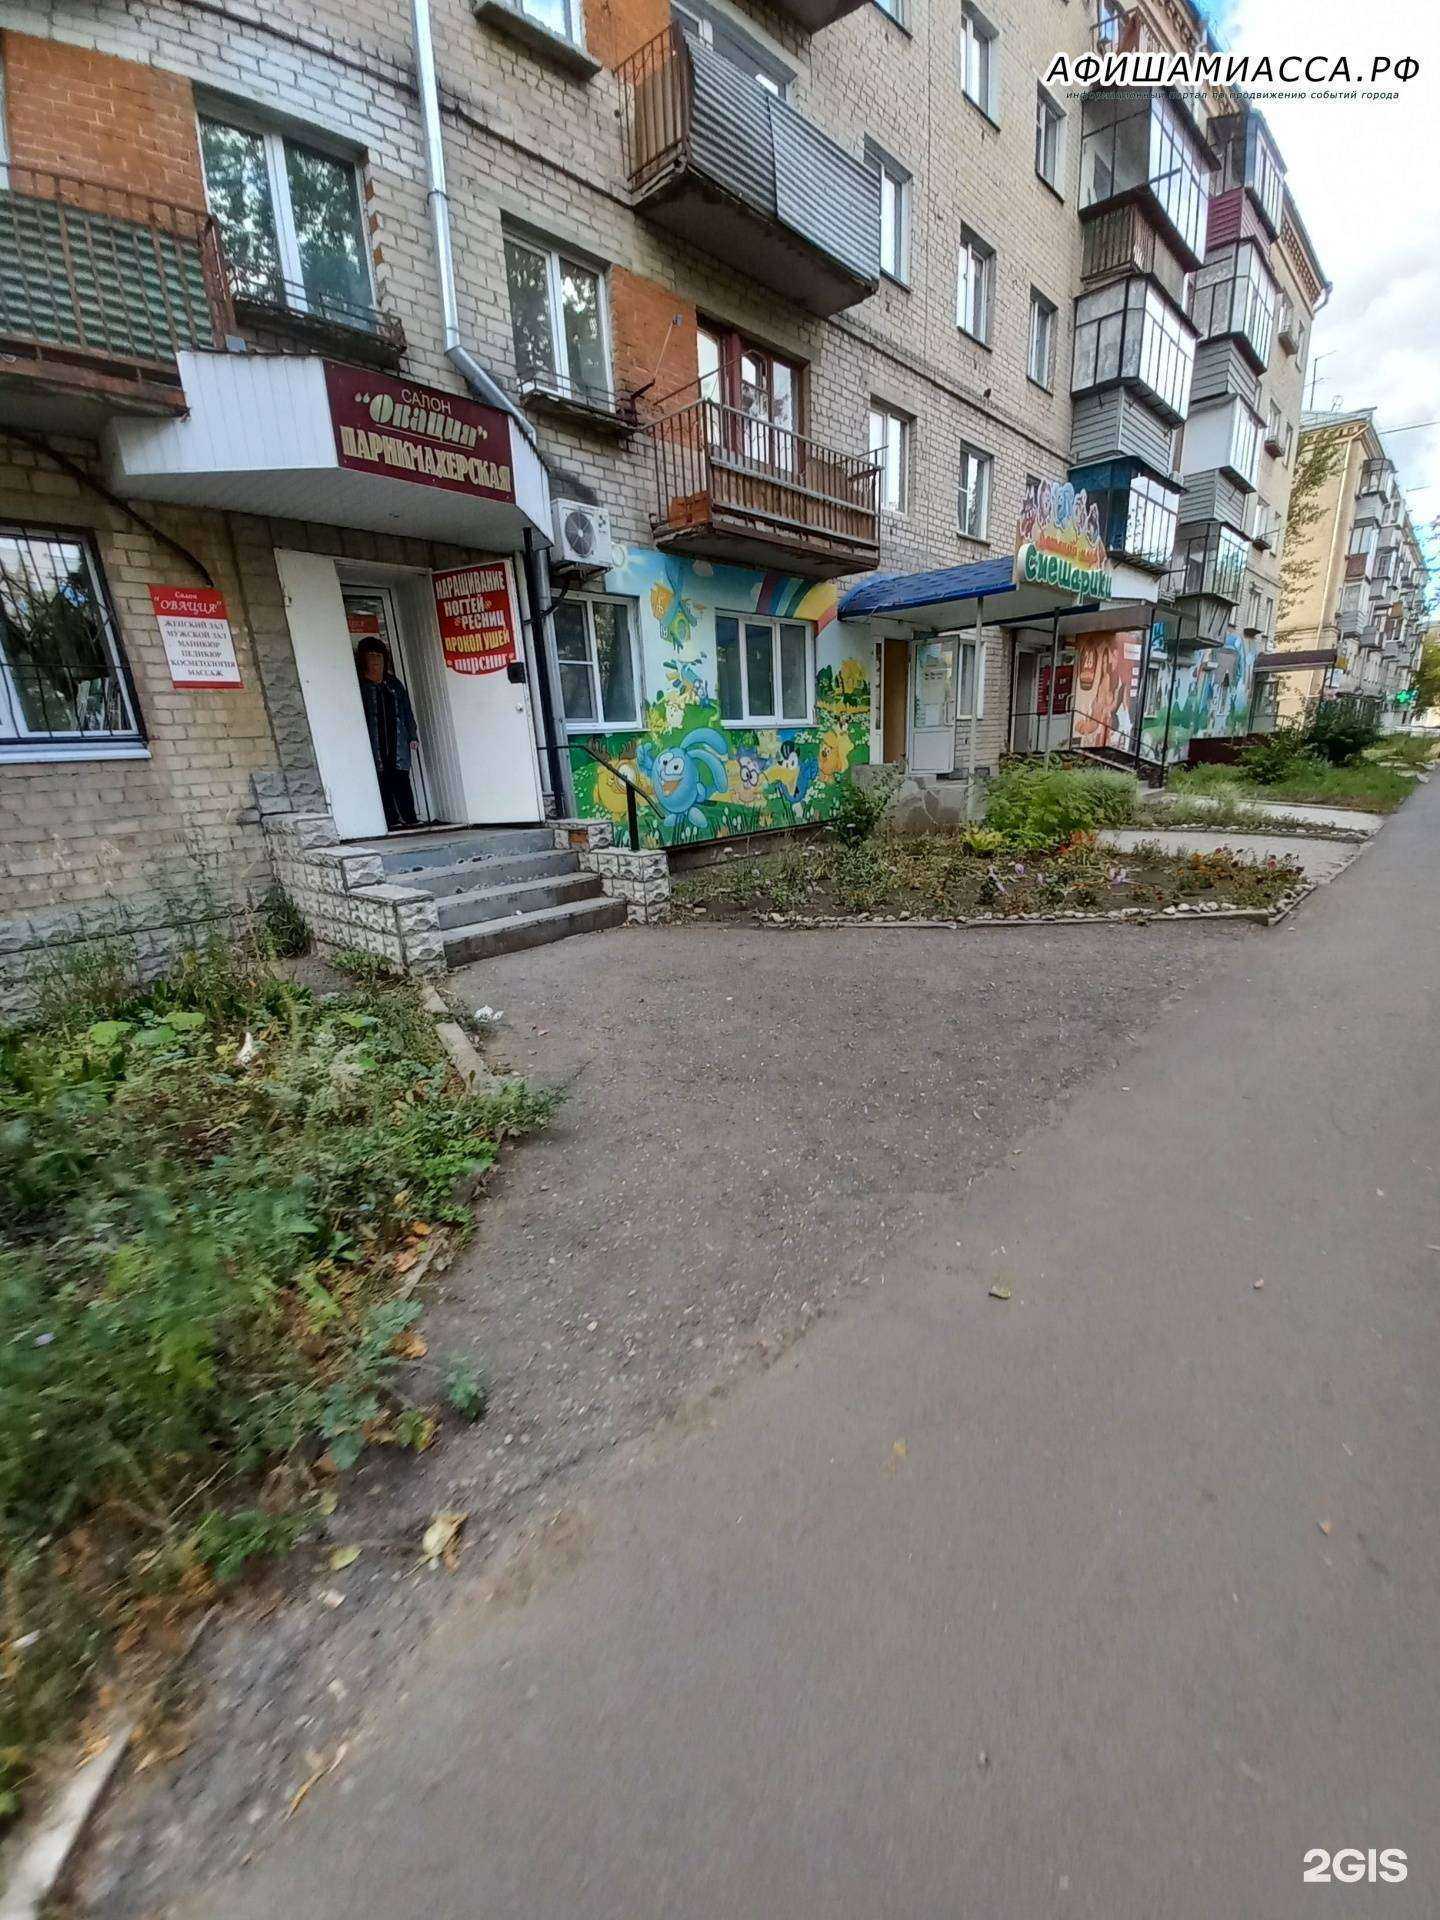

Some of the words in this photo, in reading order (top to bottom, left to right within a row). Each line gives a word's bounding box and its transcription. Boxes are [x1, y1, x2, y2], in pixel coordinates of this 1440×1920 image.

[401, 389, 452, 414] САЛОН
[340, 425, 512, 492] ПАРИКМАХЕРСКАЯ
[436, 570, 506, 600] НАРАЩИВАНИЕ
[1025, 543, 1112, 606] Смешарики
[444, 594, 485, 617] НОГТЕЙ
[165, 620, 208, 630] ЖЕНСКИЙ
[209, 622, 224, 630] ЗАЛ
[462, 610, 506, 630] РЕСНИЦ
[166, 630, 211, 639] МУЖСКОЙ
[177, 640, 220, 648] МАНИКЮР
[444, 632, 483, 653] ПРОКОЛ
[483, 628, 511, 651] УШЕЙ
[171, 660, 236, 668] КОСМЕТОЛОГИЯ
[180, 650, 222, 658] ПЕДИКЮР
